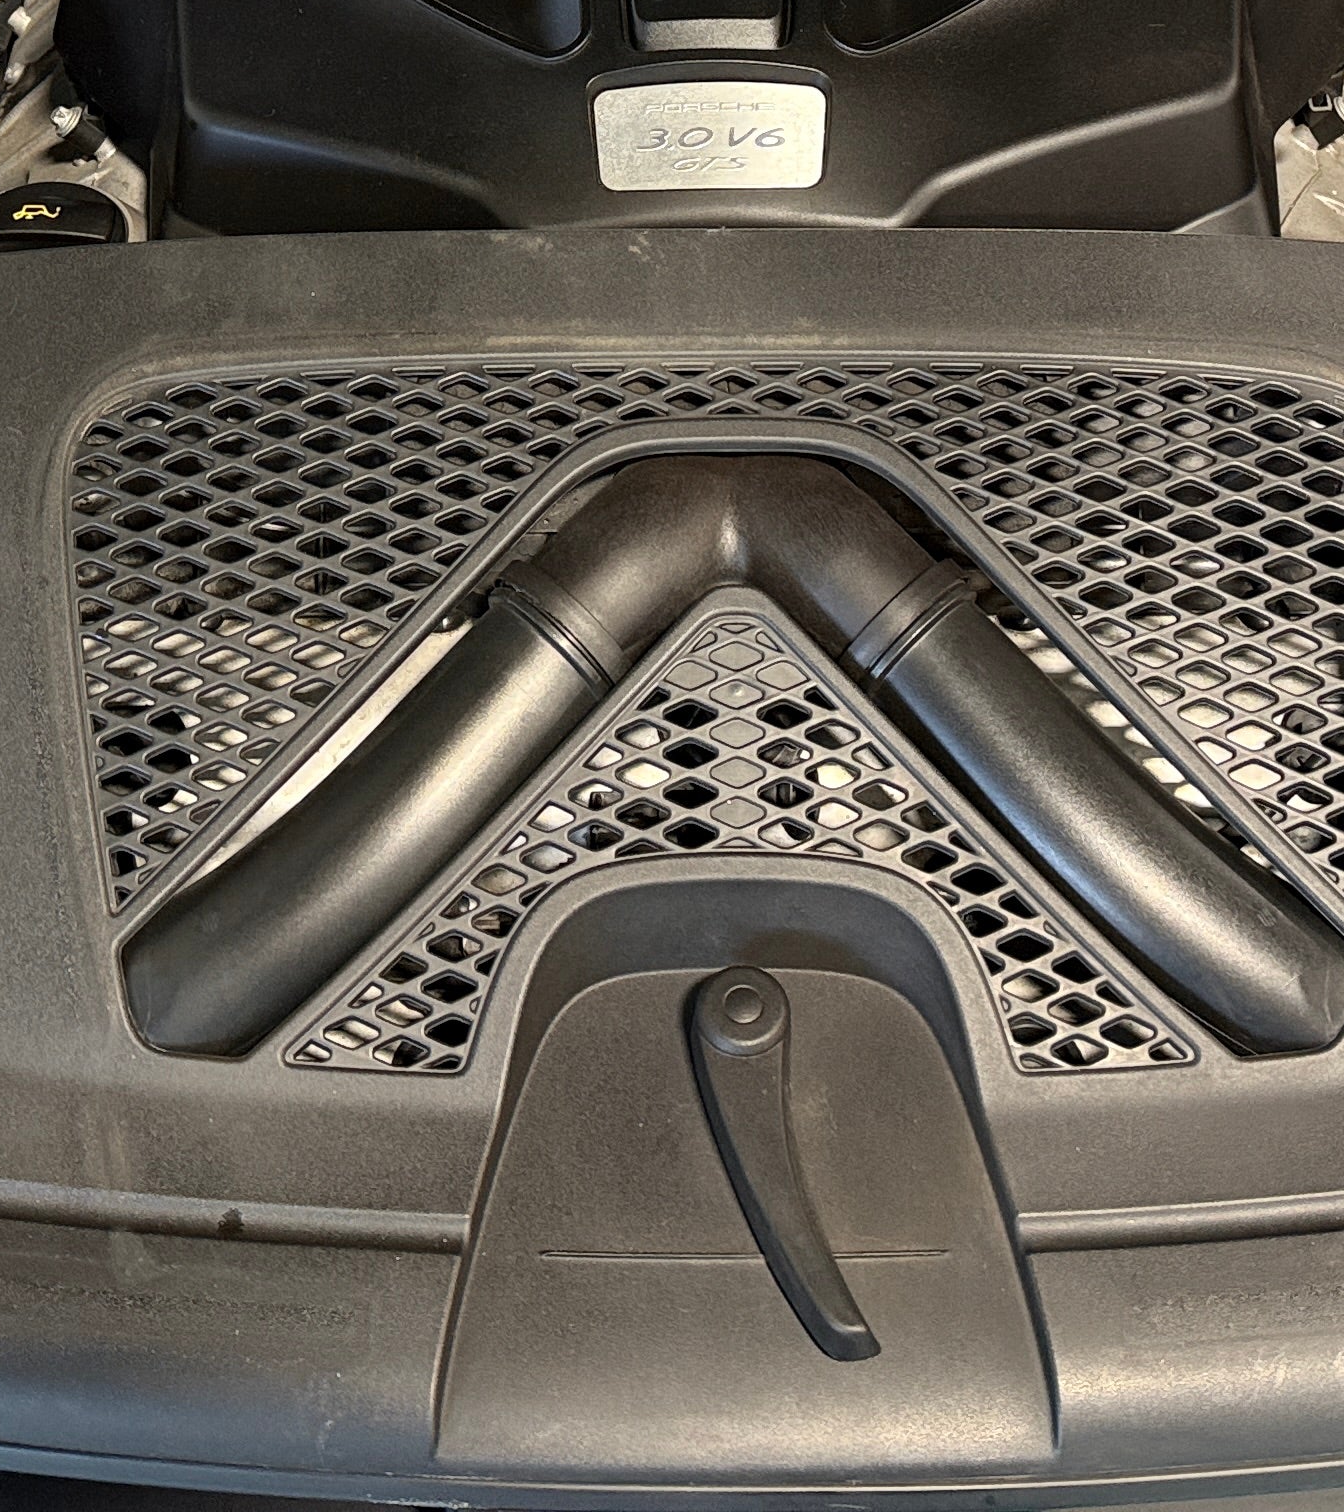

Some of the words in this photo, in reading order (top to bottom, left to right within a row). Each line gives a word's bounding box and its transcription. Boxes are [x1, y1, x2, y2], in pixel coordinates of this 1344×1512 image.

[645, 101, 776, 114] PORSCHE
[635, 126, 714, 152] 3.0
[727, 126, 786, 148] V6
[671, 156, 751, 172] GTS
